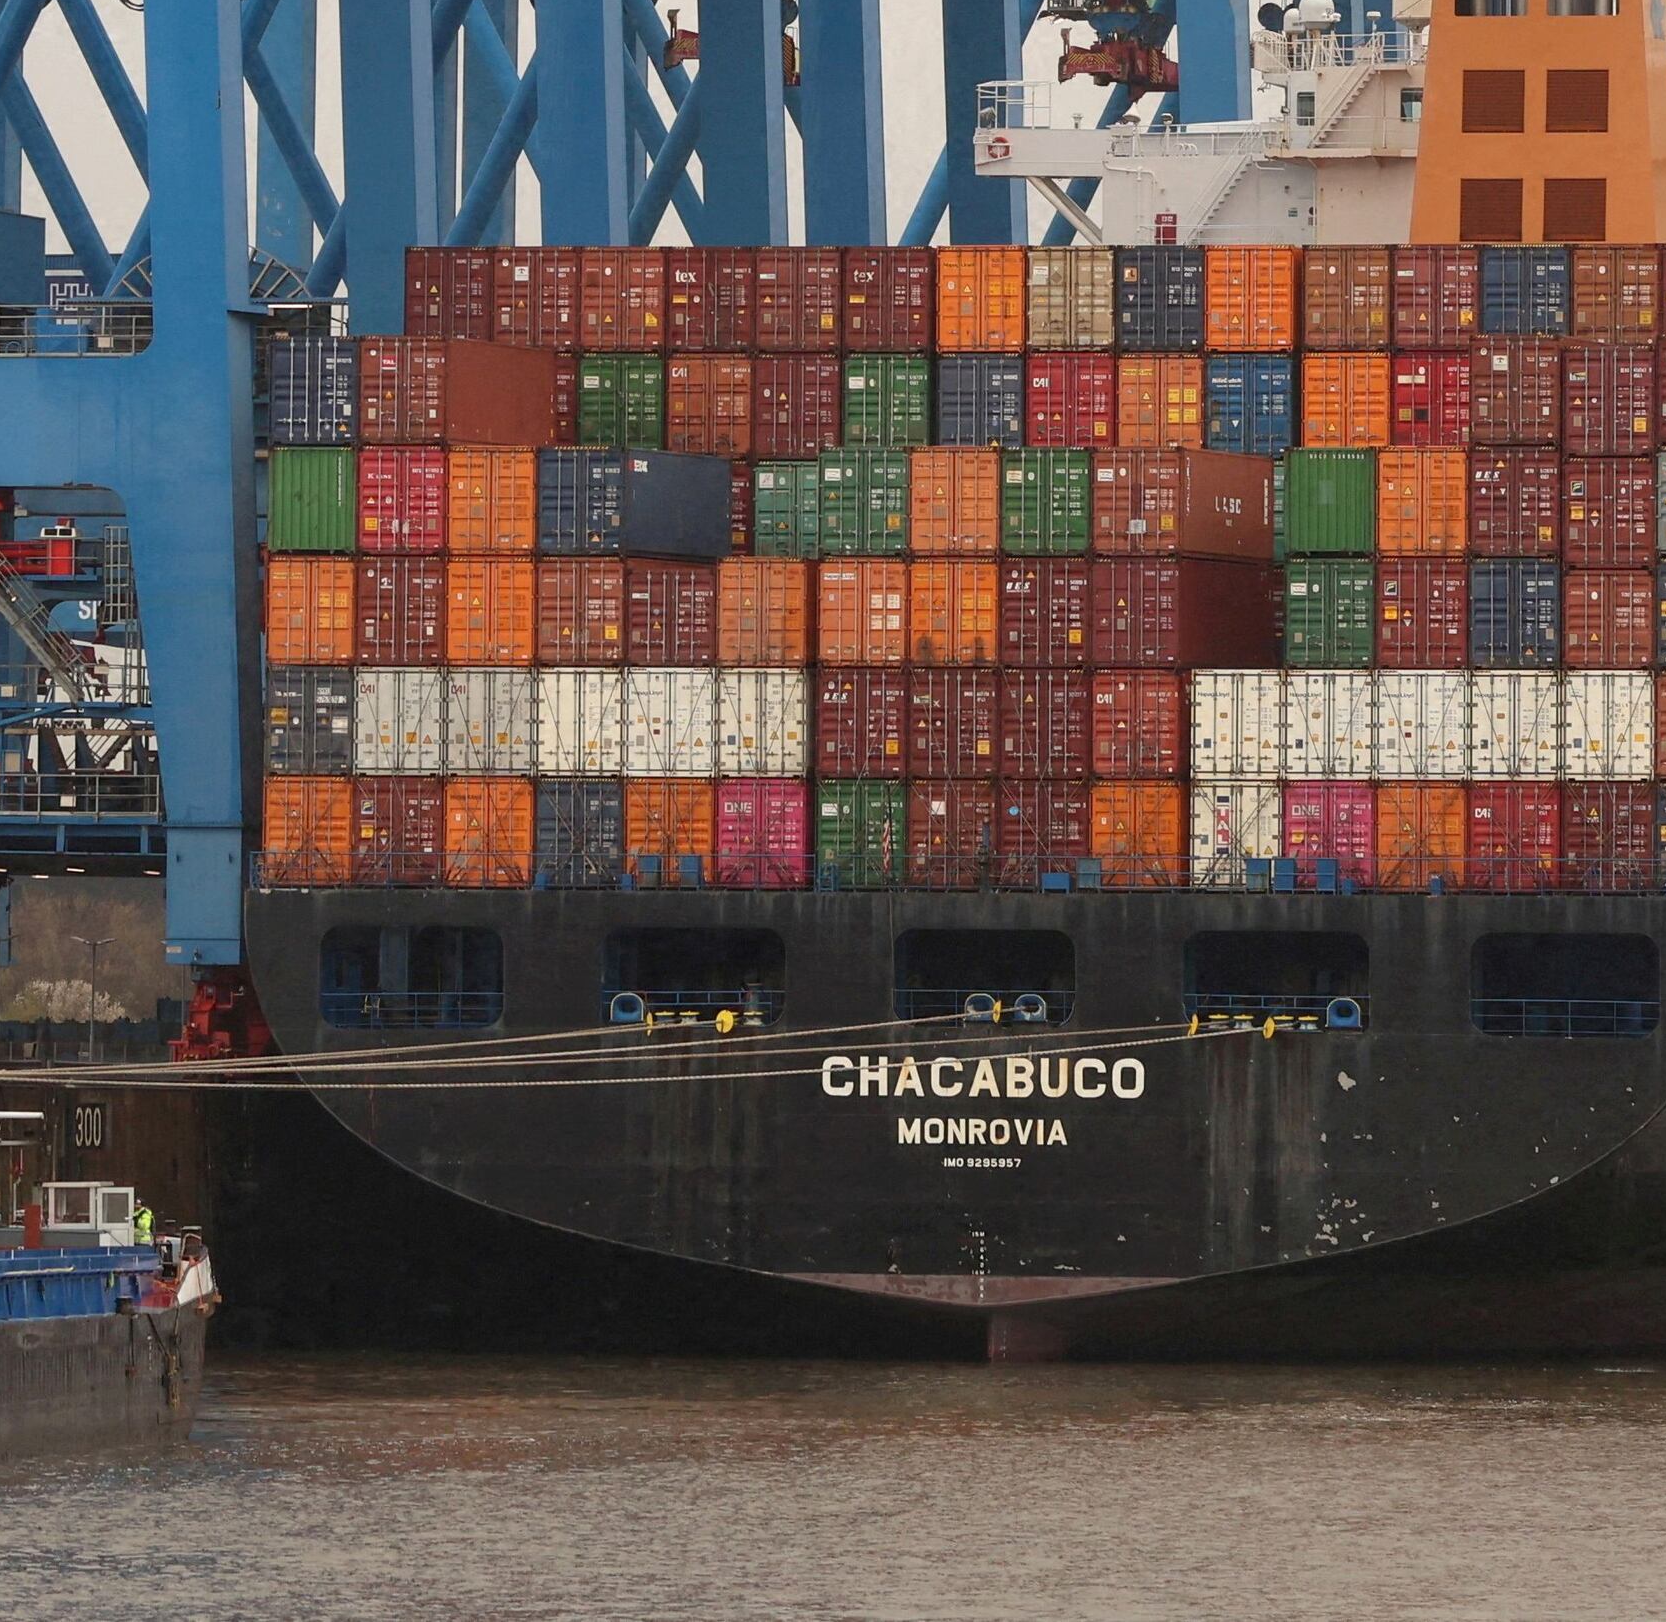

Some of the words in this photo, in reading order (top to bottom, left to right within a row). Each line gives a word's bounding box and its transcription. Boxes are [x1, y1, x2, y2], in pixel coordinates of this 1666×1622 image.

[675, 269, 696, 283] tex
[1033, 378, 1050, 388] CAI
[1096, 694, 1113, 704] CAI
[724, 802, 752, 814] ONE
[1291, 805, 1321, 816] ONE
[821, 1056, 1146, 1099] CHACABUCO
[75, 1106, 102, 1147] 300
[897, 1117, 1068, 1146] MONROVIA
[943, 1158, 964, 1167] IMO
[967, 1158, 1022, 1168] 9295957
